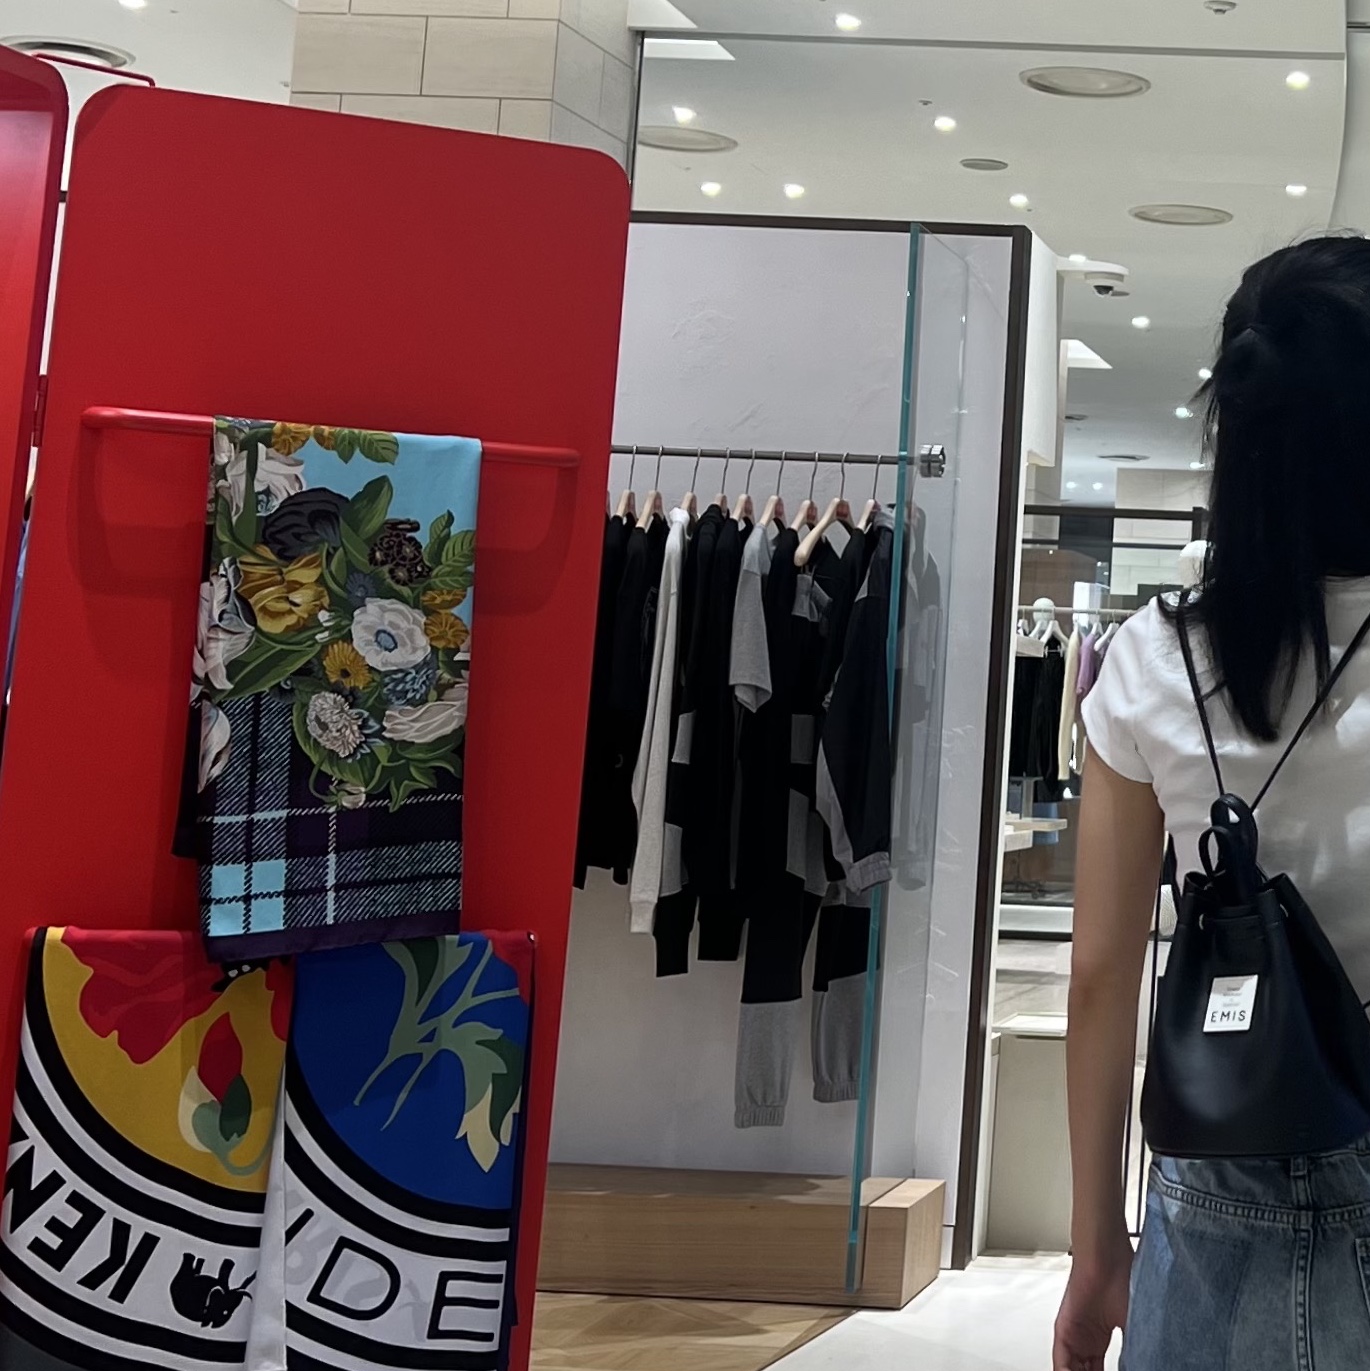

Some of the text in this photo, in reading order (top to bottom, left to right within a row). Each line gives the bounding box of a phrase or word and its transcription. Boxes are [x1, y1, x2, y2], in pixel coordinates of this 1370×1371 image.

[1210, 1010, 1247, 1023] EMIS
[3, 1115, 160, 1304] KEN
[285, 1207, 504, 1342] DE
